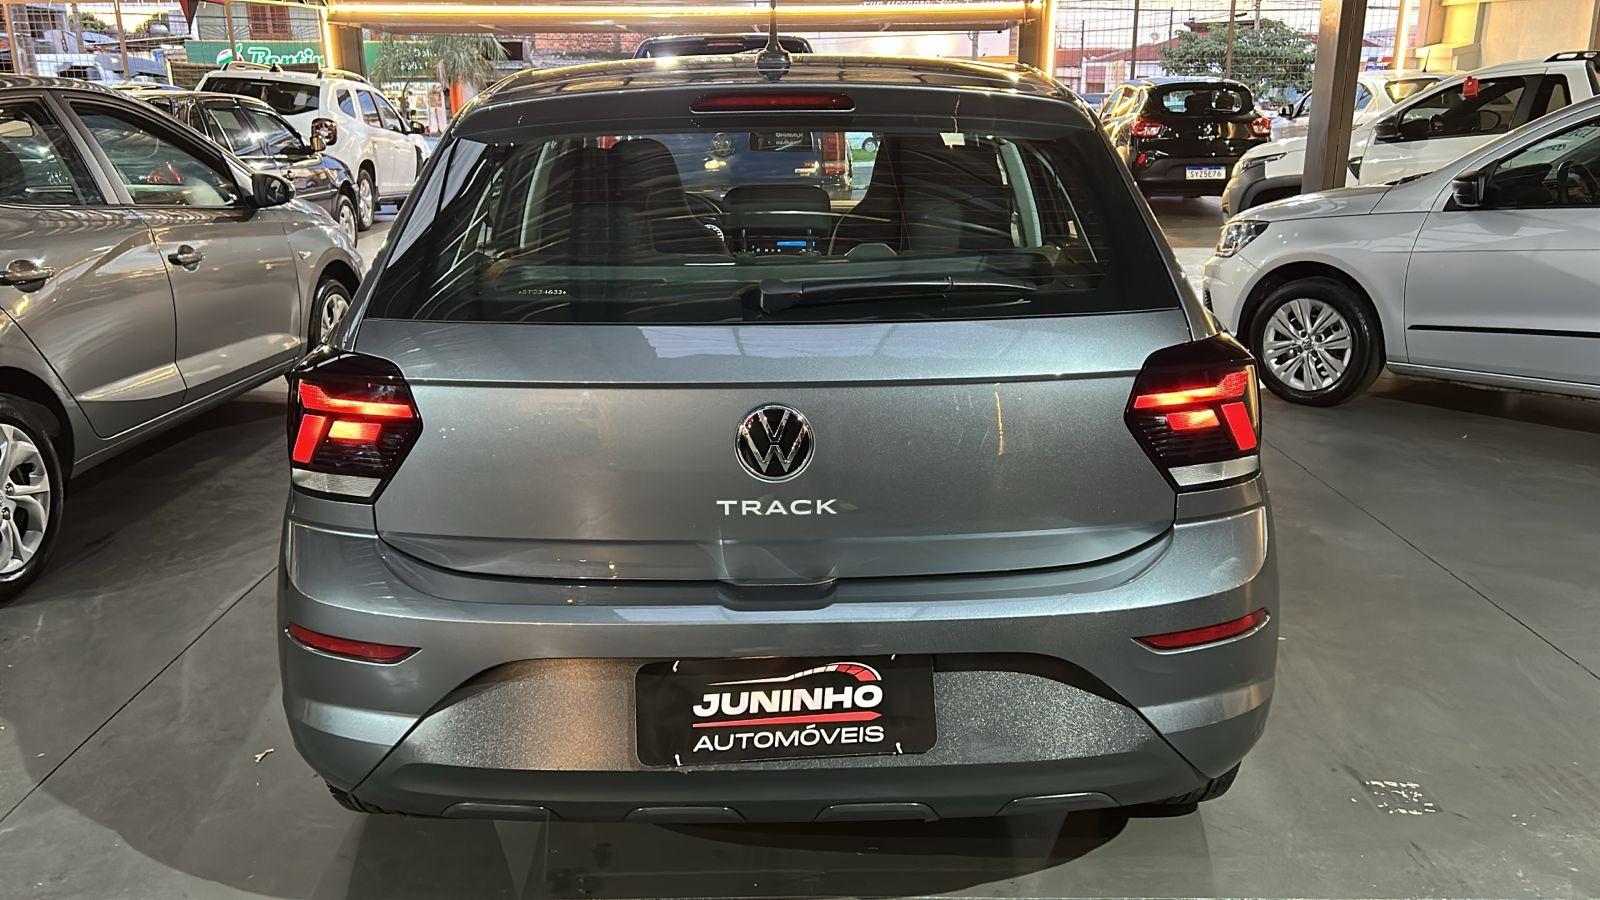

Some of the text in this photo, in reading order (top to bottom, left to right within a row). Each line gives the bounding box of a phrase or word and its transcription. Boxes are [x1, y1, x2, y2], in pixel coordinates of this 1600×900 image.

[716, 499, 838, 516] TRACK
[692, 684, 883, 717] JUNINHO
[692, 724, 884, 752] AUTOMÓVEIS
